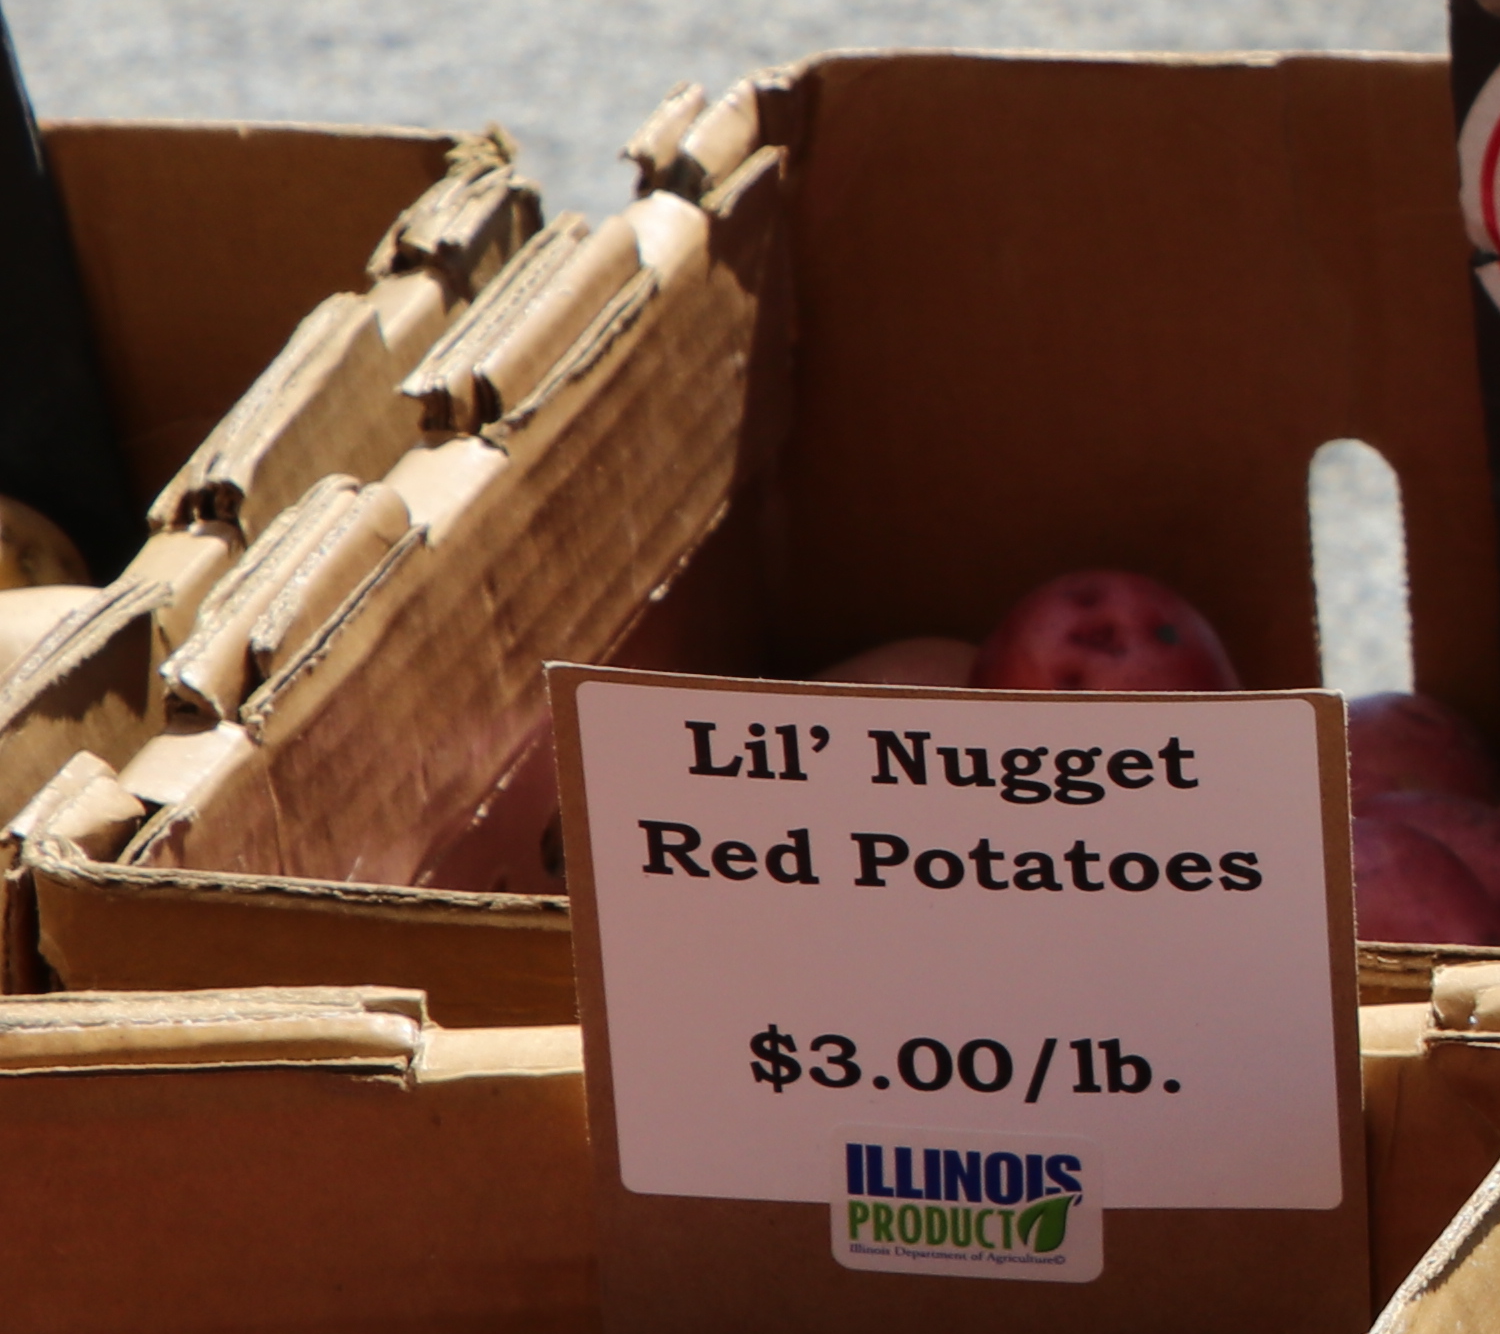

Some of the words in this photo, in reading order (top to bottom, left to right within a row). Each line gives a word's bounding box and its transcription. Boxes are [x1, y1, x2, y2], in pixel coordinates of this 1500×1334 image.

[867, 730, 1199, 806] Nugget
[637, 819, 820, 885] Red
[850, 832, 1263, 892] Potatoes
[749, 1023, 1181, 1104] $3.00/lb.
[846, 1142, 1083, 1206] ILLINOIS
[849, 1243, 891, 1257] Illinois
[895, 1245, 967, 1263] Department
[970, 1250, 984, 1262] of
